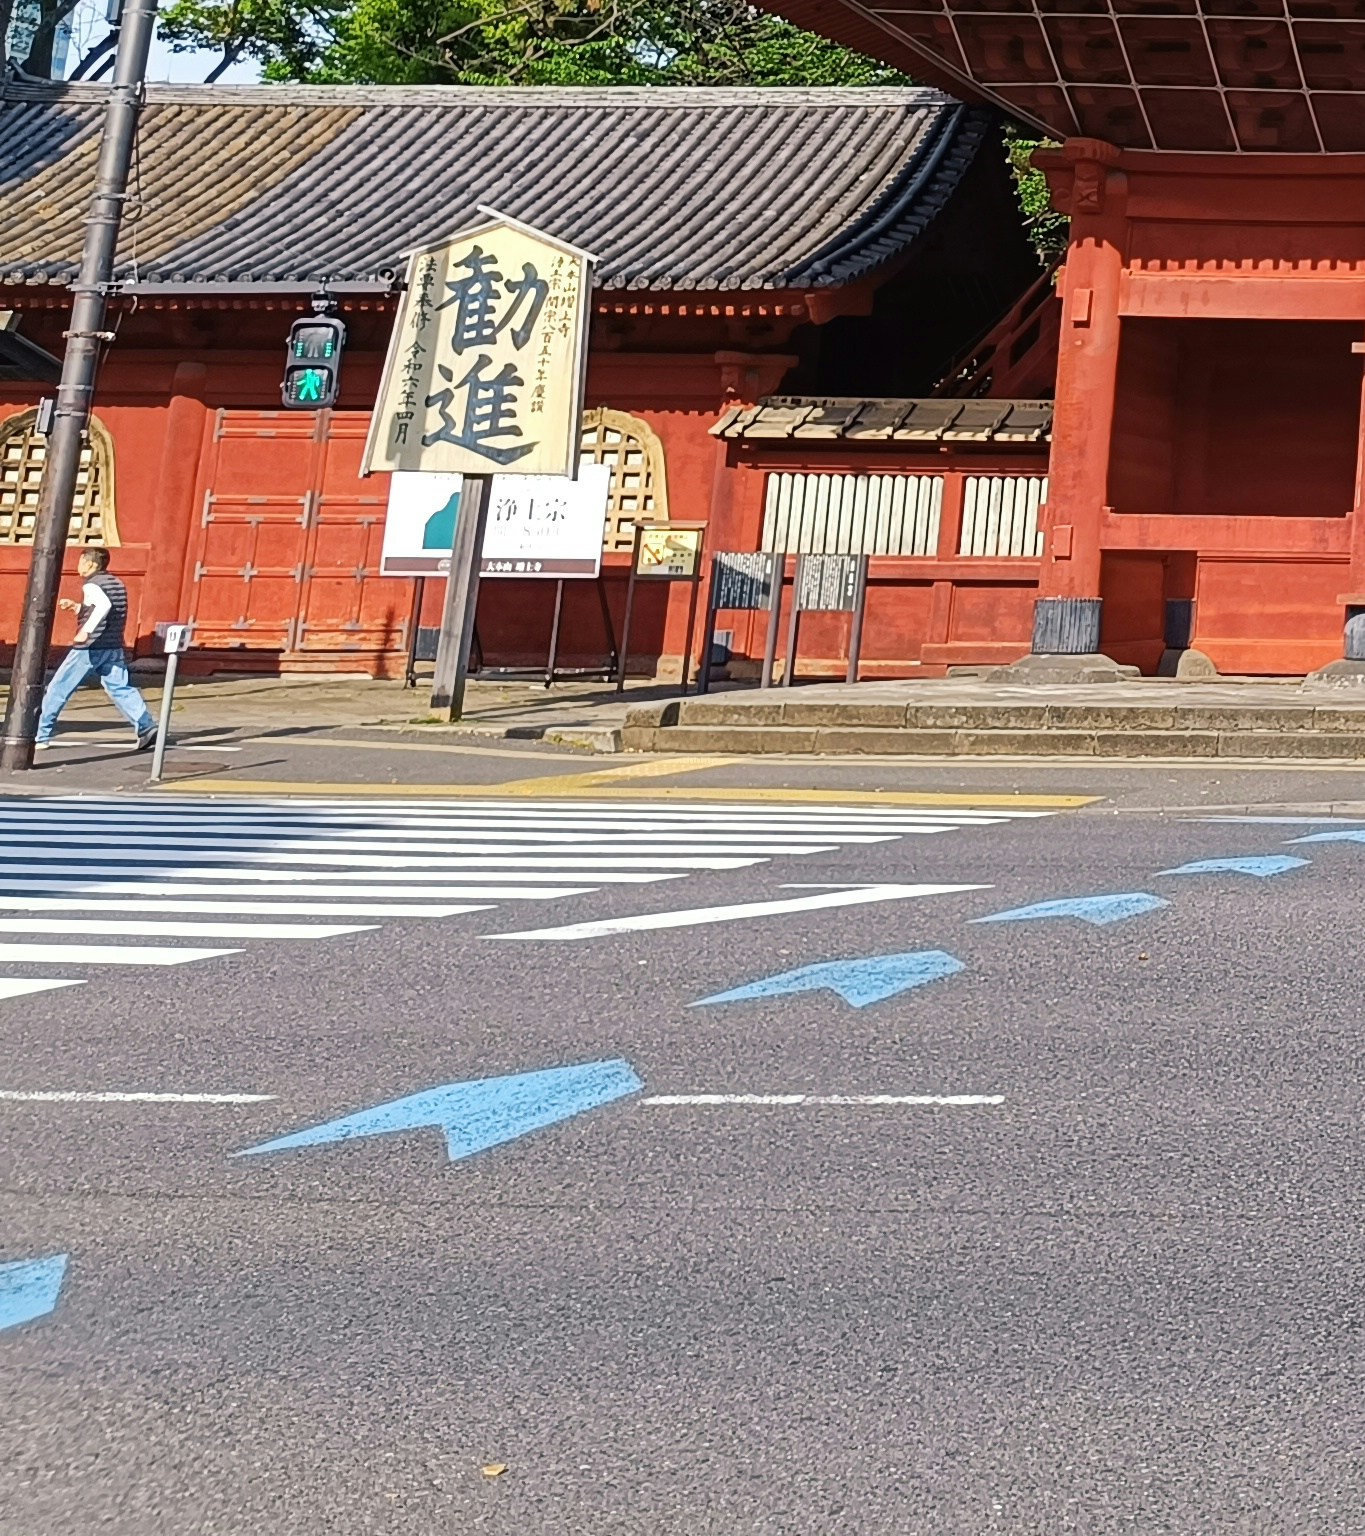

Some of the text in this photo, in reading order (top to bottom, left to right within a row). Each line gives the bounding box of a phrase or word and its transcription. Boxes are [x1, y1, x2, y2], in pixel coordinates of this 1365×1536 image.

[421, 244, 550, 465] 勧進
[557, 256, 580, 338] 大本山増上寺
